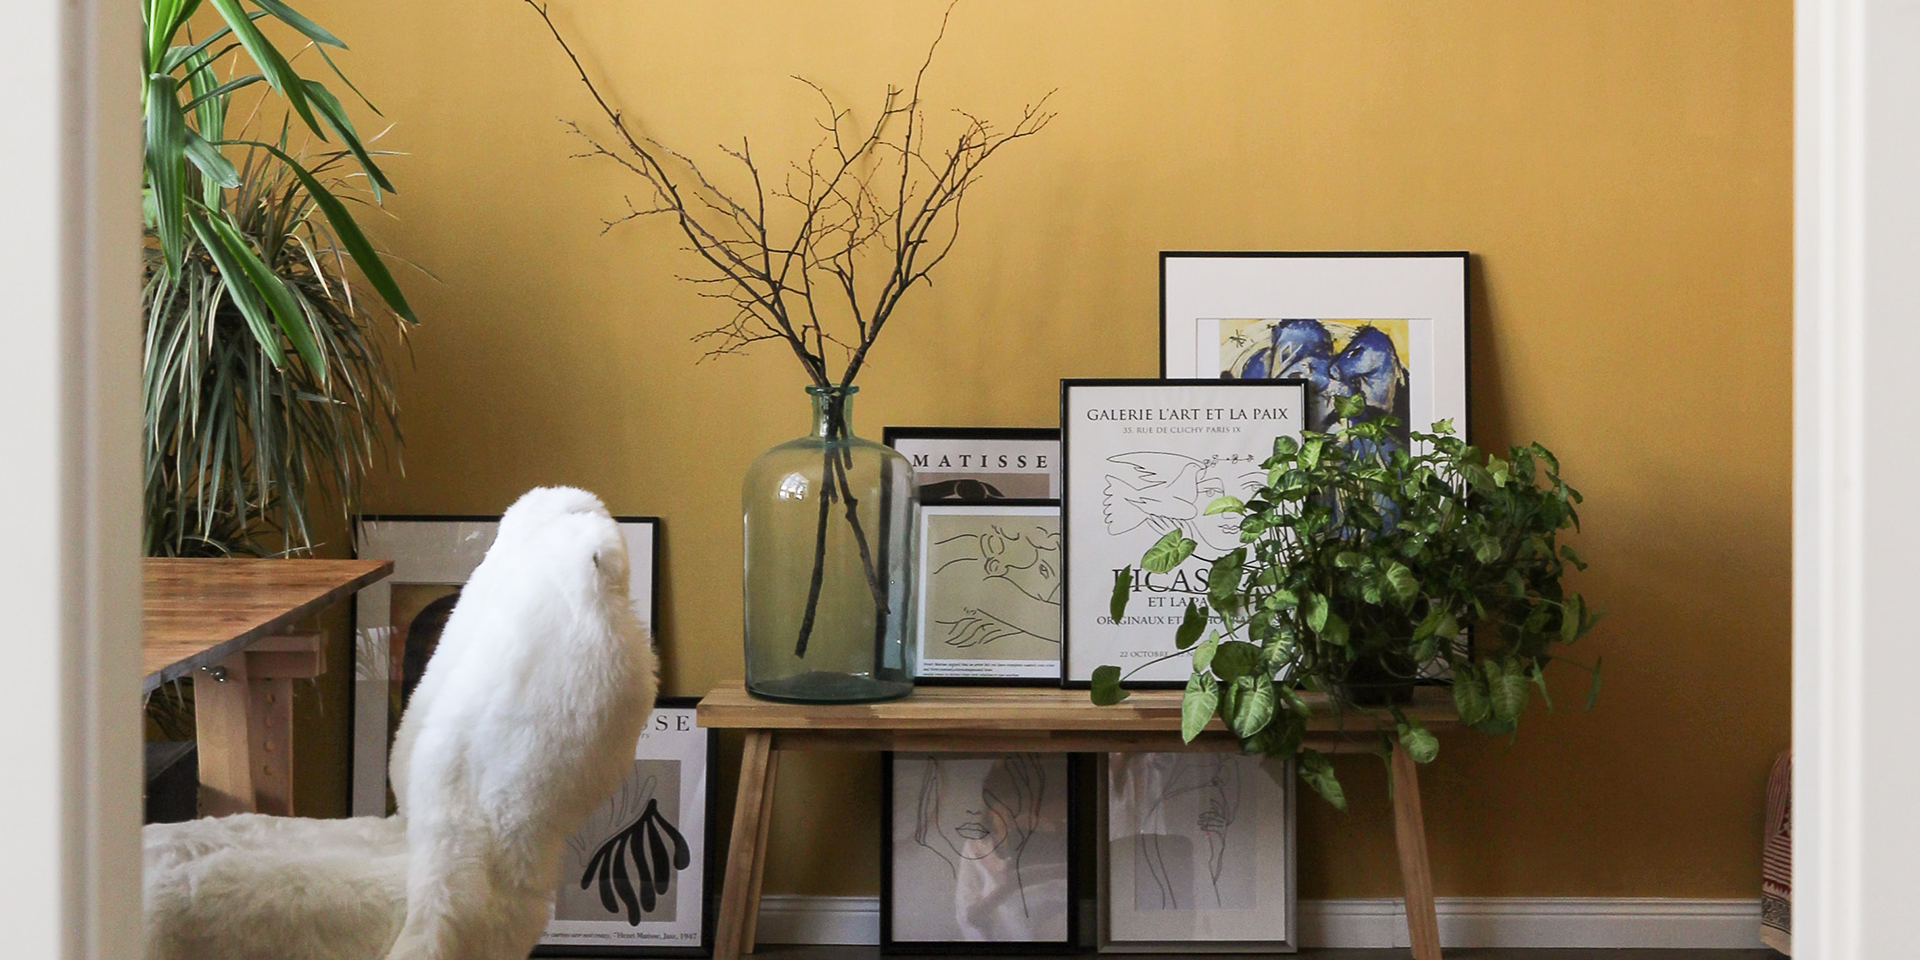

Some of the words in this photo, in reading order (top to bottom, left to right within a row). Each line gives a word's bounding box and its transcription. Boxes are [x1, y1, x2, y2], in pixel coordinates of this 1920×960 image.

[1086, 408, 1153, 421] GALERIE
[1159, 408, 1201, 421] L'ART
[1206, 408, 1224, 420] ET
[1229, 408, 1248, 420] LA
[1253, 408, 1289, 420] PAIX
[1136, 426, 1153, 434] RUE
[1156, 426, 1167, 434] DE
[1170, 426, 1204, 434] CLICHY
[1206, 426, 1230, 434] PARIS
[912, 454, 1048, 469] MATISSE
[1148, 596, 1166, 607] ET
[1170, 596, 1187, 607] LA
[1096, 615, 1165, 625] ORGINAUX
[1167, 615, 1182, 625] ET
[1119, 650, 1128, 658] 22
[680, 932, 698, 940] 1947
